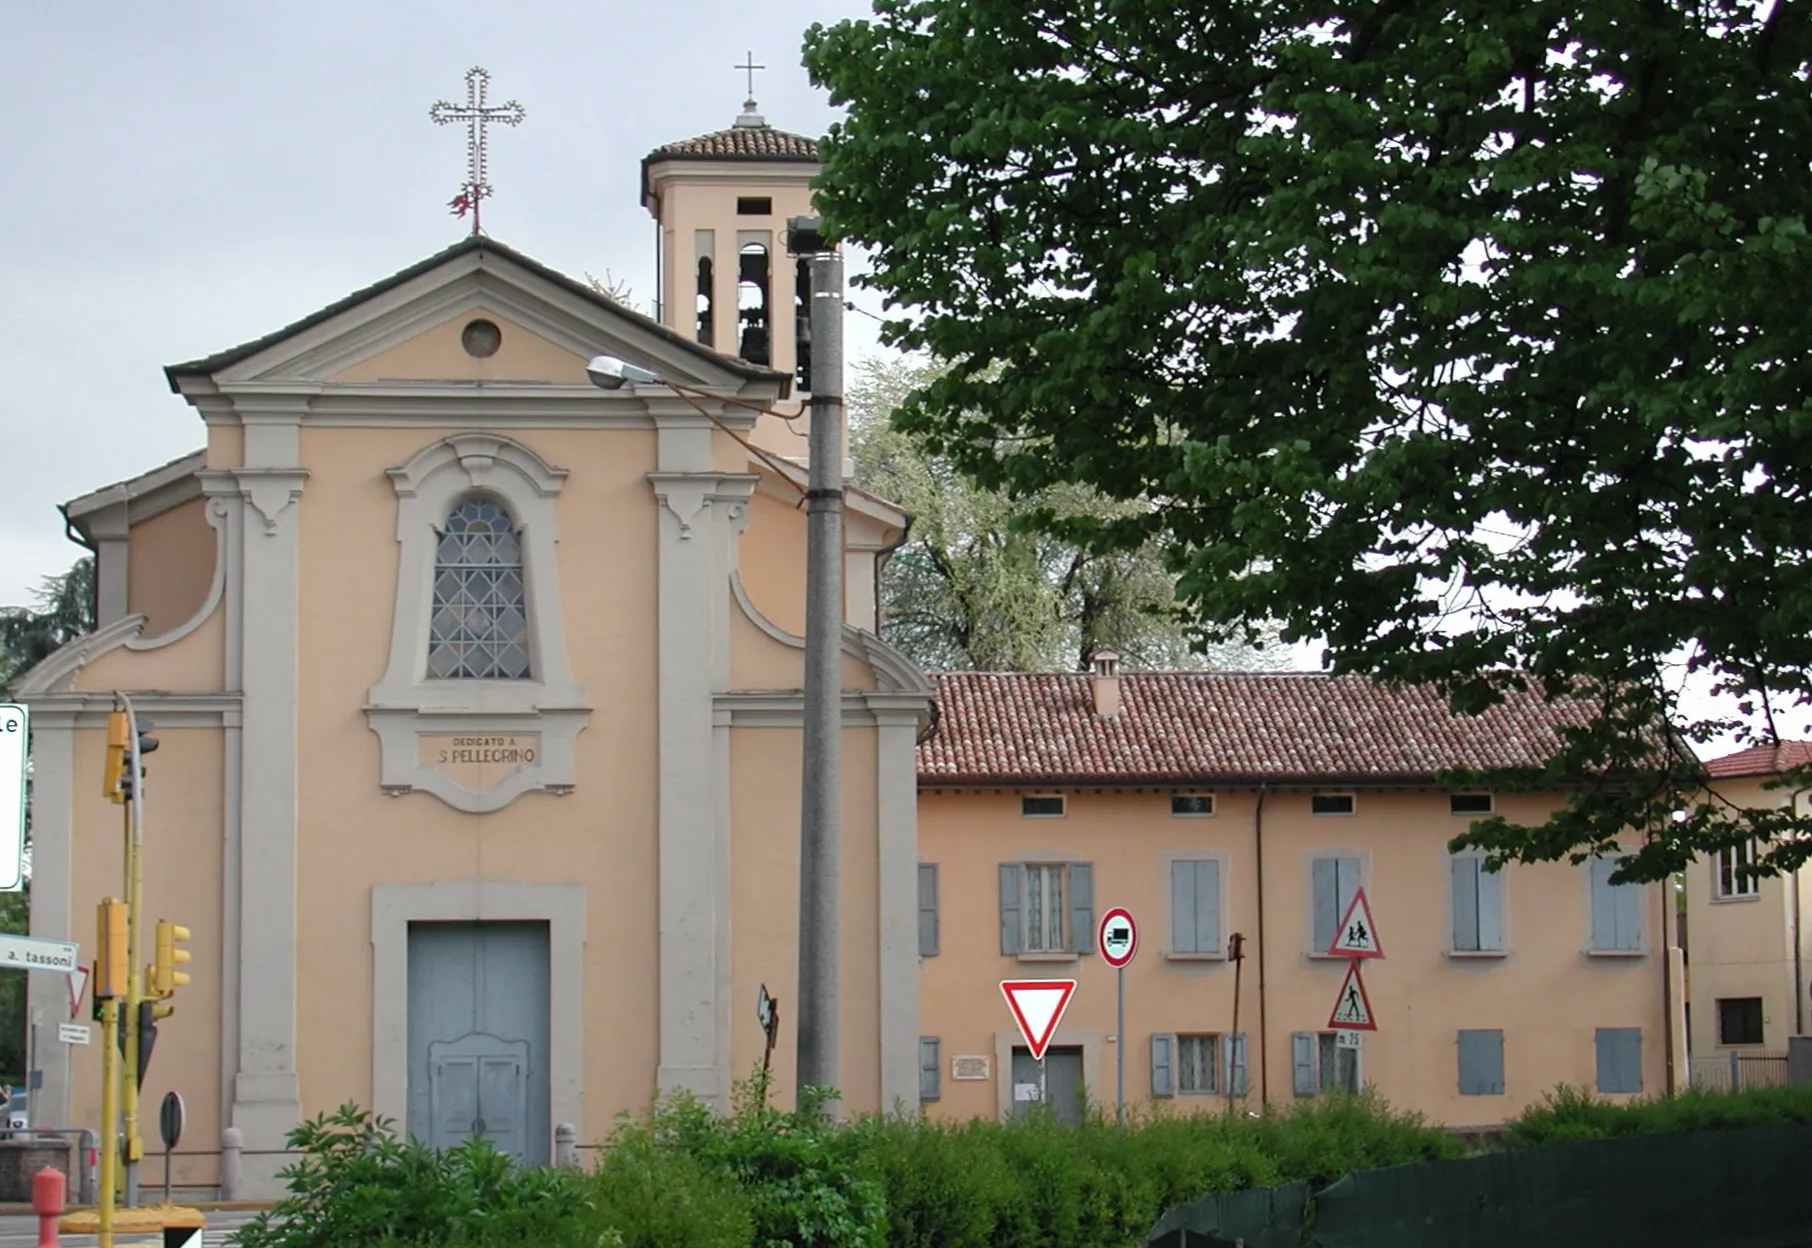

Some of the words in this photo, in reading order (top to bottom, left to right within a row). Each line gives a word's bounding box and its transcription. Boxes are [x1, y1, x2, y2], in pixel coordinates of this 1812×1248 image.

[452, 738, 505, 747] DEDICATO
[509, 738, 517, 747] A
[452, 748, 535, 764] PELLEGRINO
[26, 951, 72, 967] tassoni
